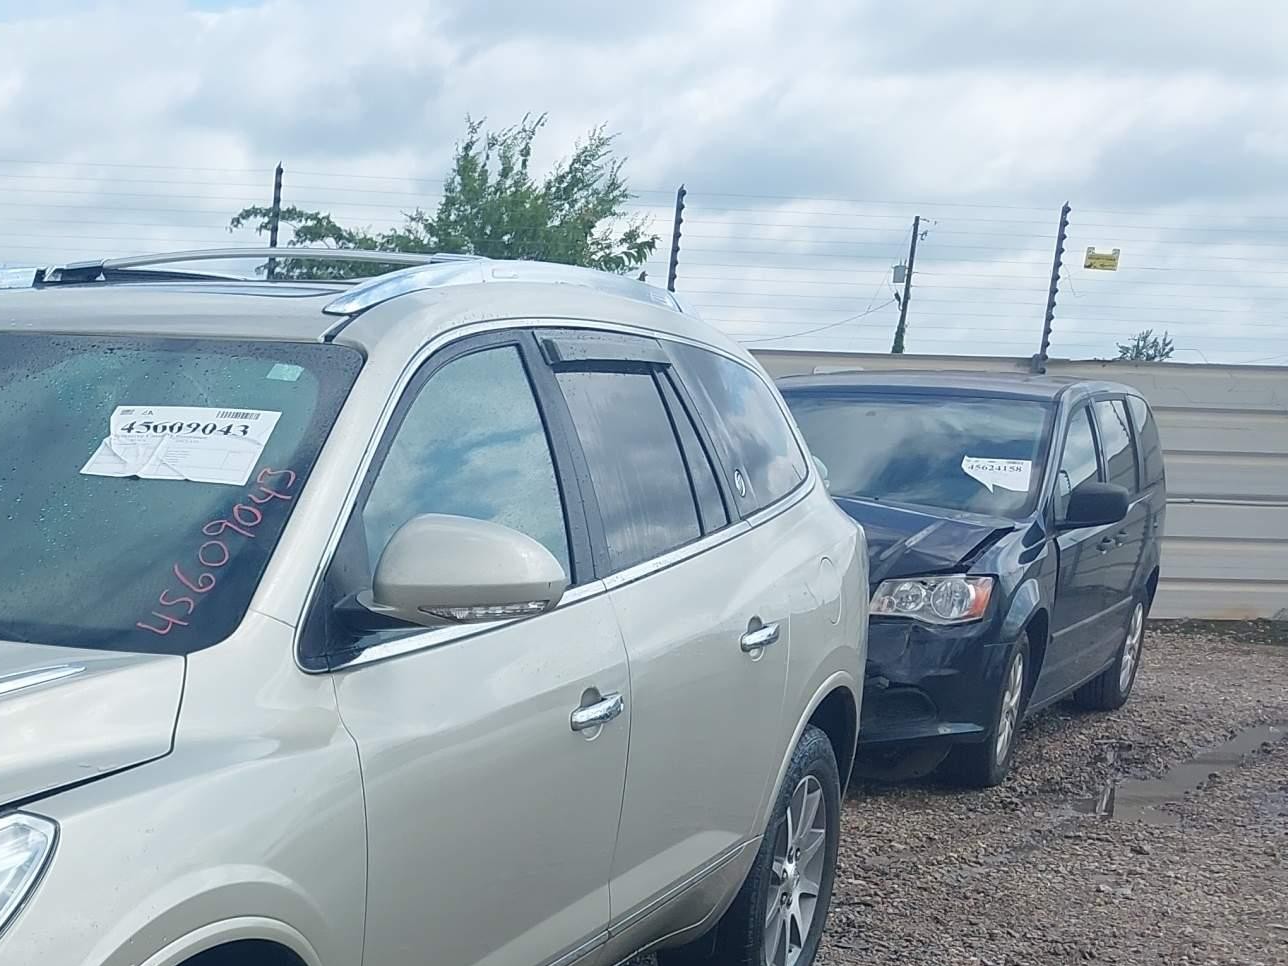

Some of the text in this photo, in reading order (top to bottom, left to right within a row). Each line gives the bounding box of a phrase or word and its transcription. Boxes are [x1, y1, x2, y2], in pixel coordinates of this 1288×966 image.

[120, 420, 250, 436] 45609043
[969, 464, 1023, 473] 45624158
[136, 467, 296, 635] 45609043
